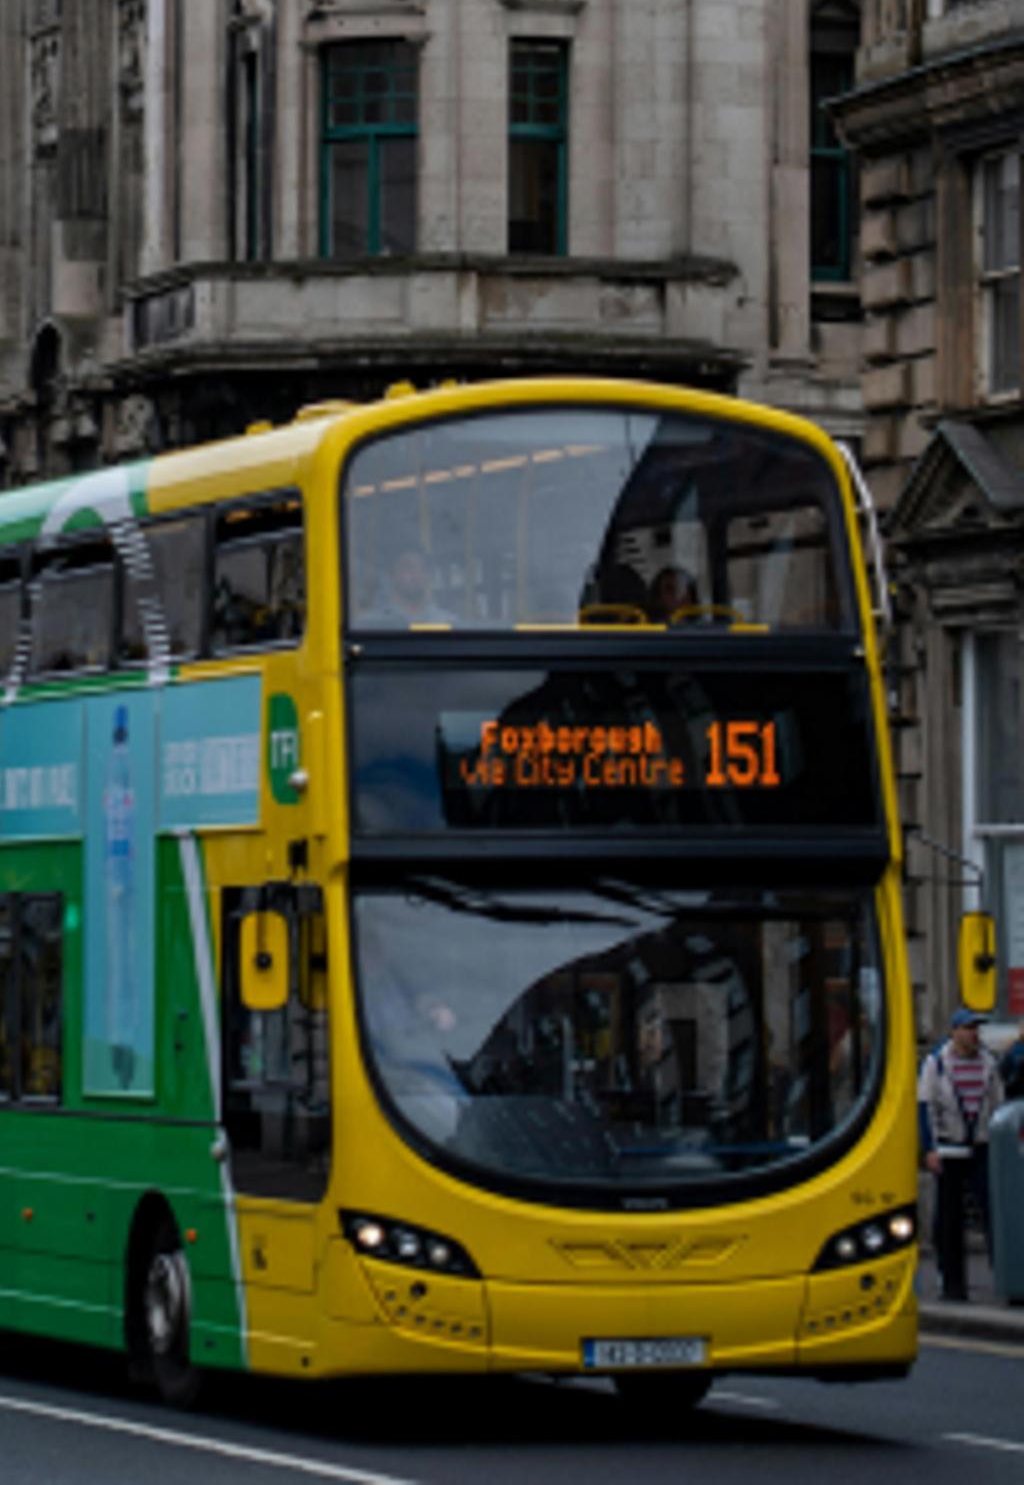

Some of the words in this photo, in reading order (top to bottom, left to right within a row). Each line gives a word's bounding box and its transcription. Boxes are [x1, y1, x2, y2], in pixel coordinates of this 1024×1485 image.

[481, 721, 662, 755] Foxborough
[706, 721, 780, 786] 151
[515, 754, 575, 786] City
[583, 754, 684, 786] Centre
